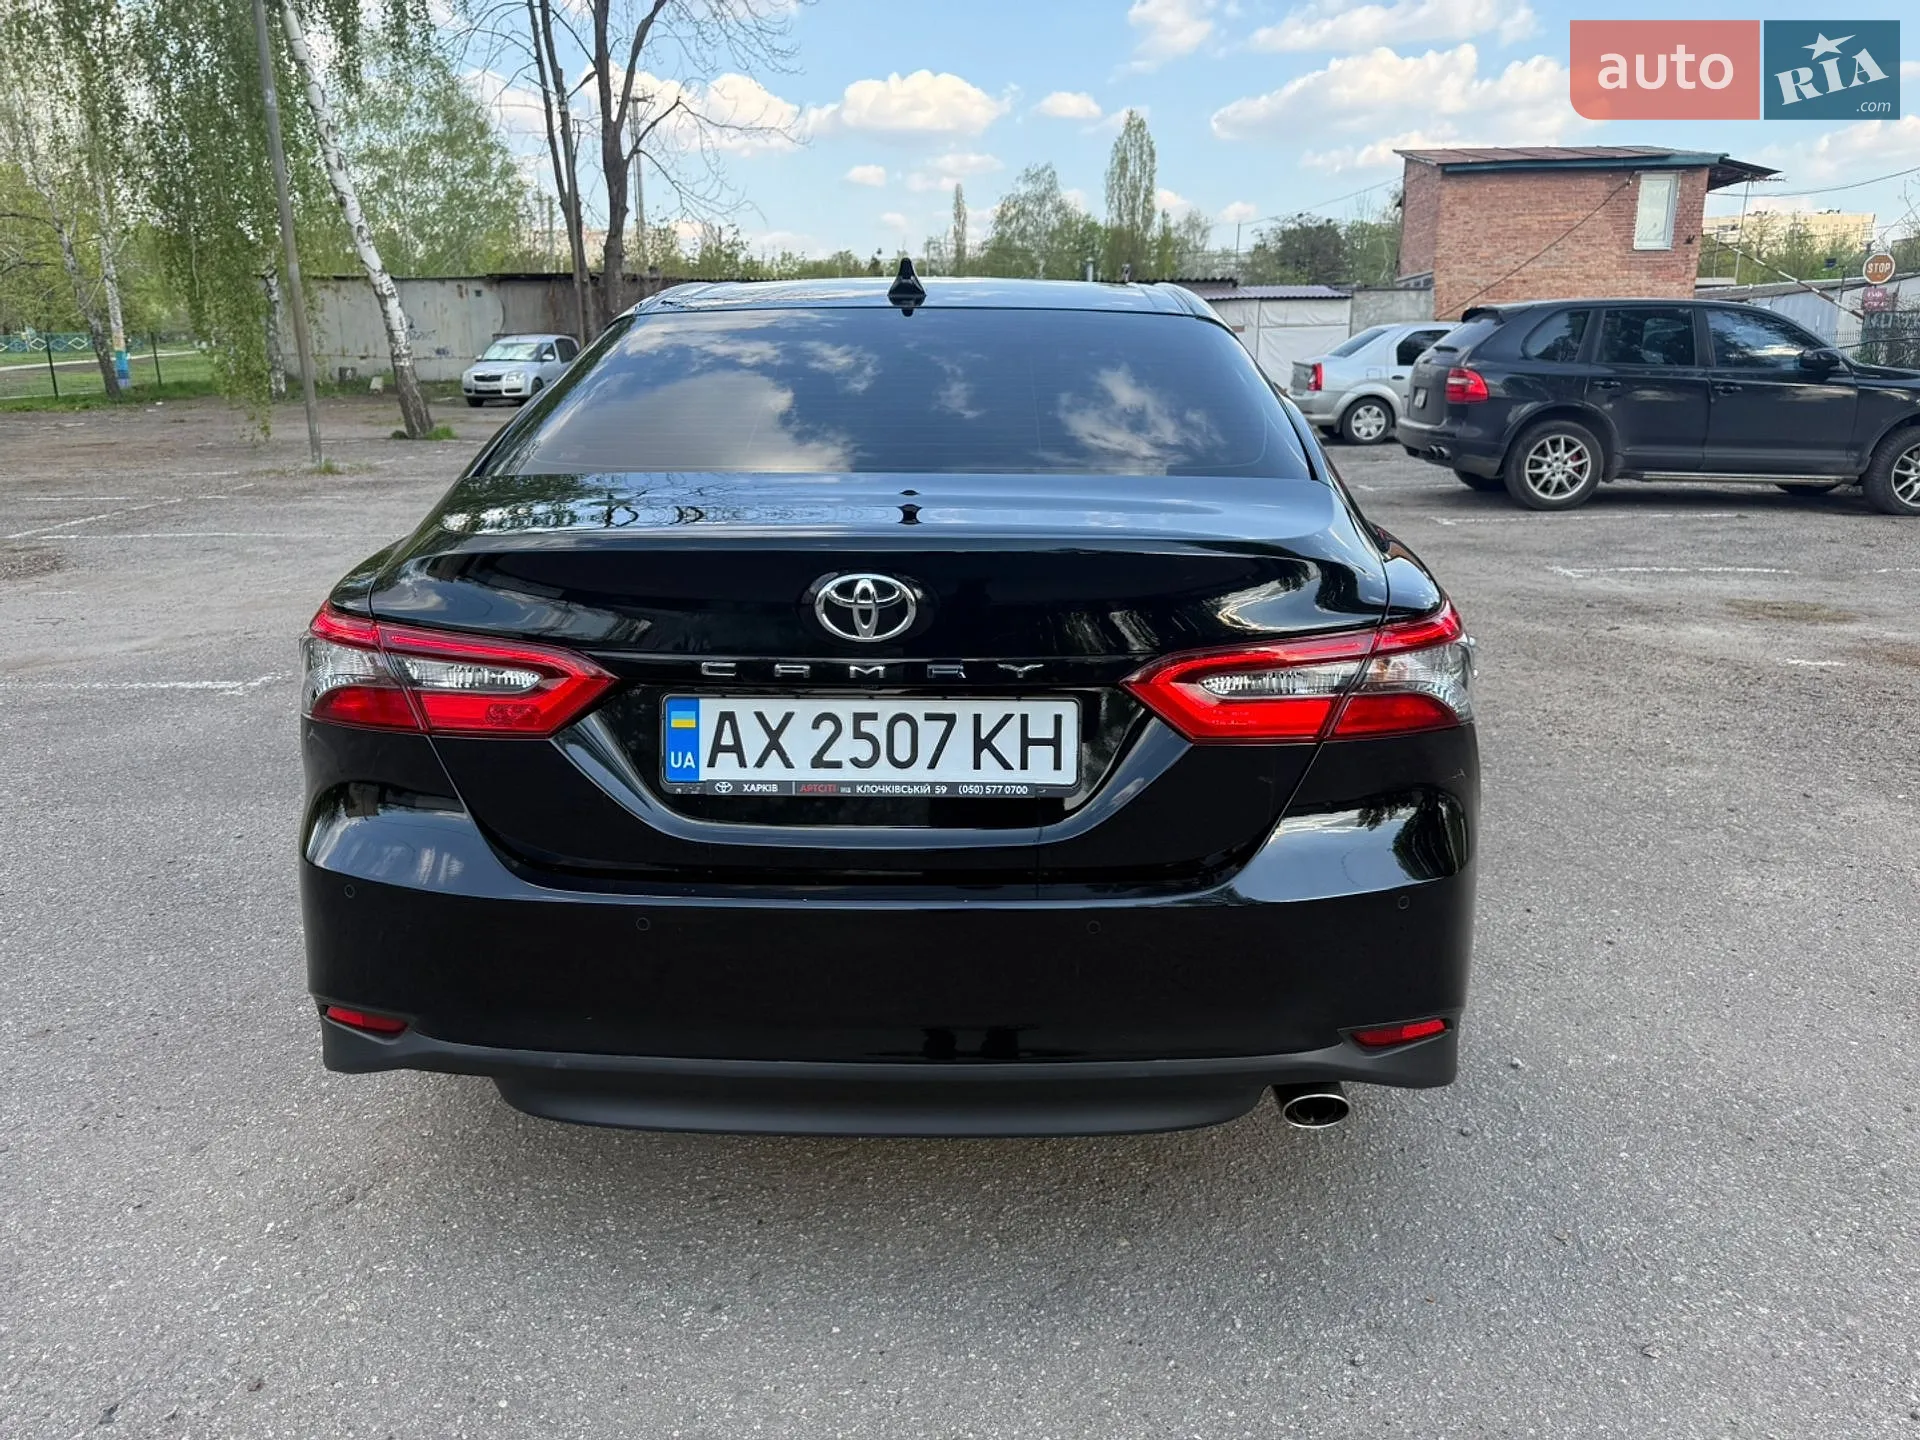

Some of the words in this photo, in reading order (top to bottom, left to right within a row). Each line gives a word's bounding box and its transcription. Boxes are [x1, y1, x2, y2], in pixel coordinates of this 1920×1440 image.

[1867, 262, 1891, 273] STOP
[701, 661, 1044, 679] CAMRY
[707, 711, 795, 768] AX
[811, 712, 957, 770] 2507
[973, 713, 1063, 771] KH
[670, 751, 696, 768] UA
[743, 783, 778, 793] ХАРКІВ
[856, 783, 931, 794] КЛОЧКІВСЬКІЙ
[934, 785, 948, 794] 59
[958, 785, 983, 795] (050)
[985, 785, 1002, 795] 577
[1004, 785, 1028, 795] 0700
